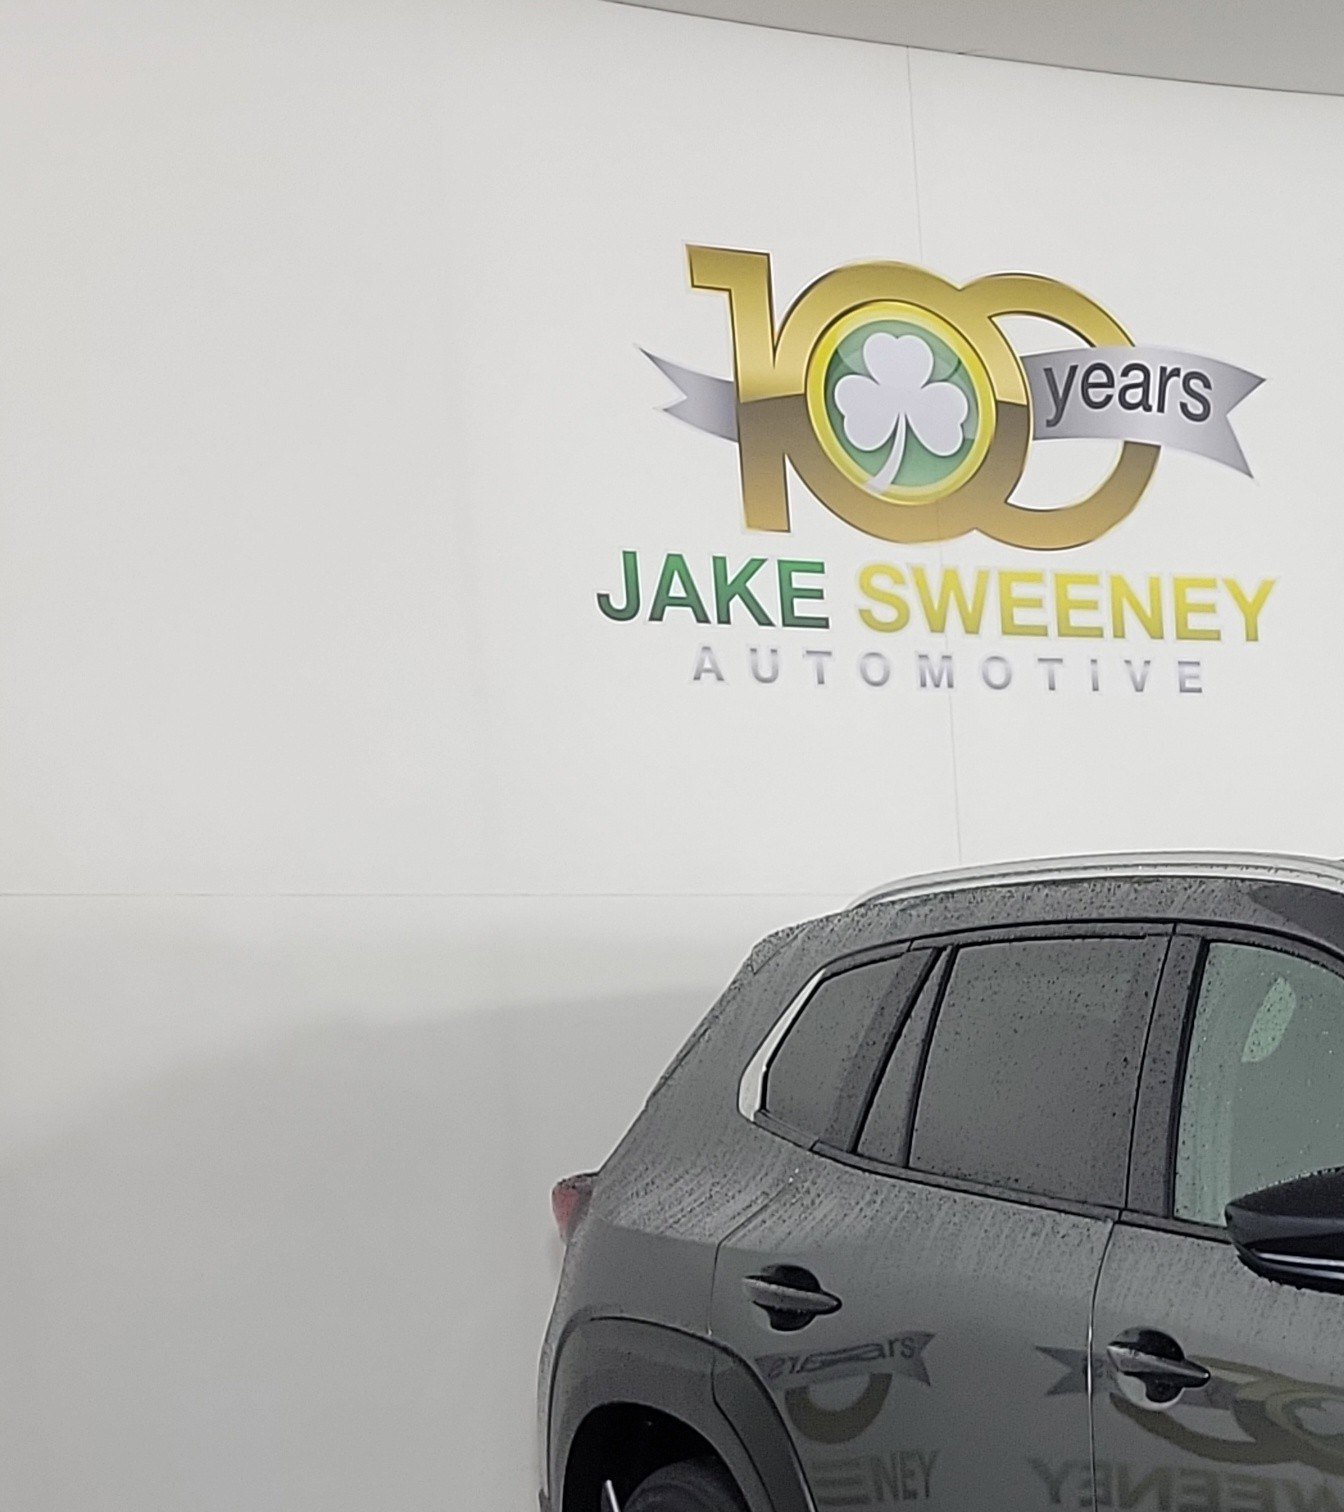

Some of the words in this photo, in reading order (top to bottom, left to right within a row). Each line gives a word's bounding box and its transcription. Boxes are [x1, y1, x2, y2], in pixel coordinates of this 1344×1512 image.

[1043, 361, 1213, 427] years
[597, 550, 830, 630] JAKE
[856, 563, 1277, 642] SWEENEY
[692, 646, 1203, 694] AUTOMOTIVE
